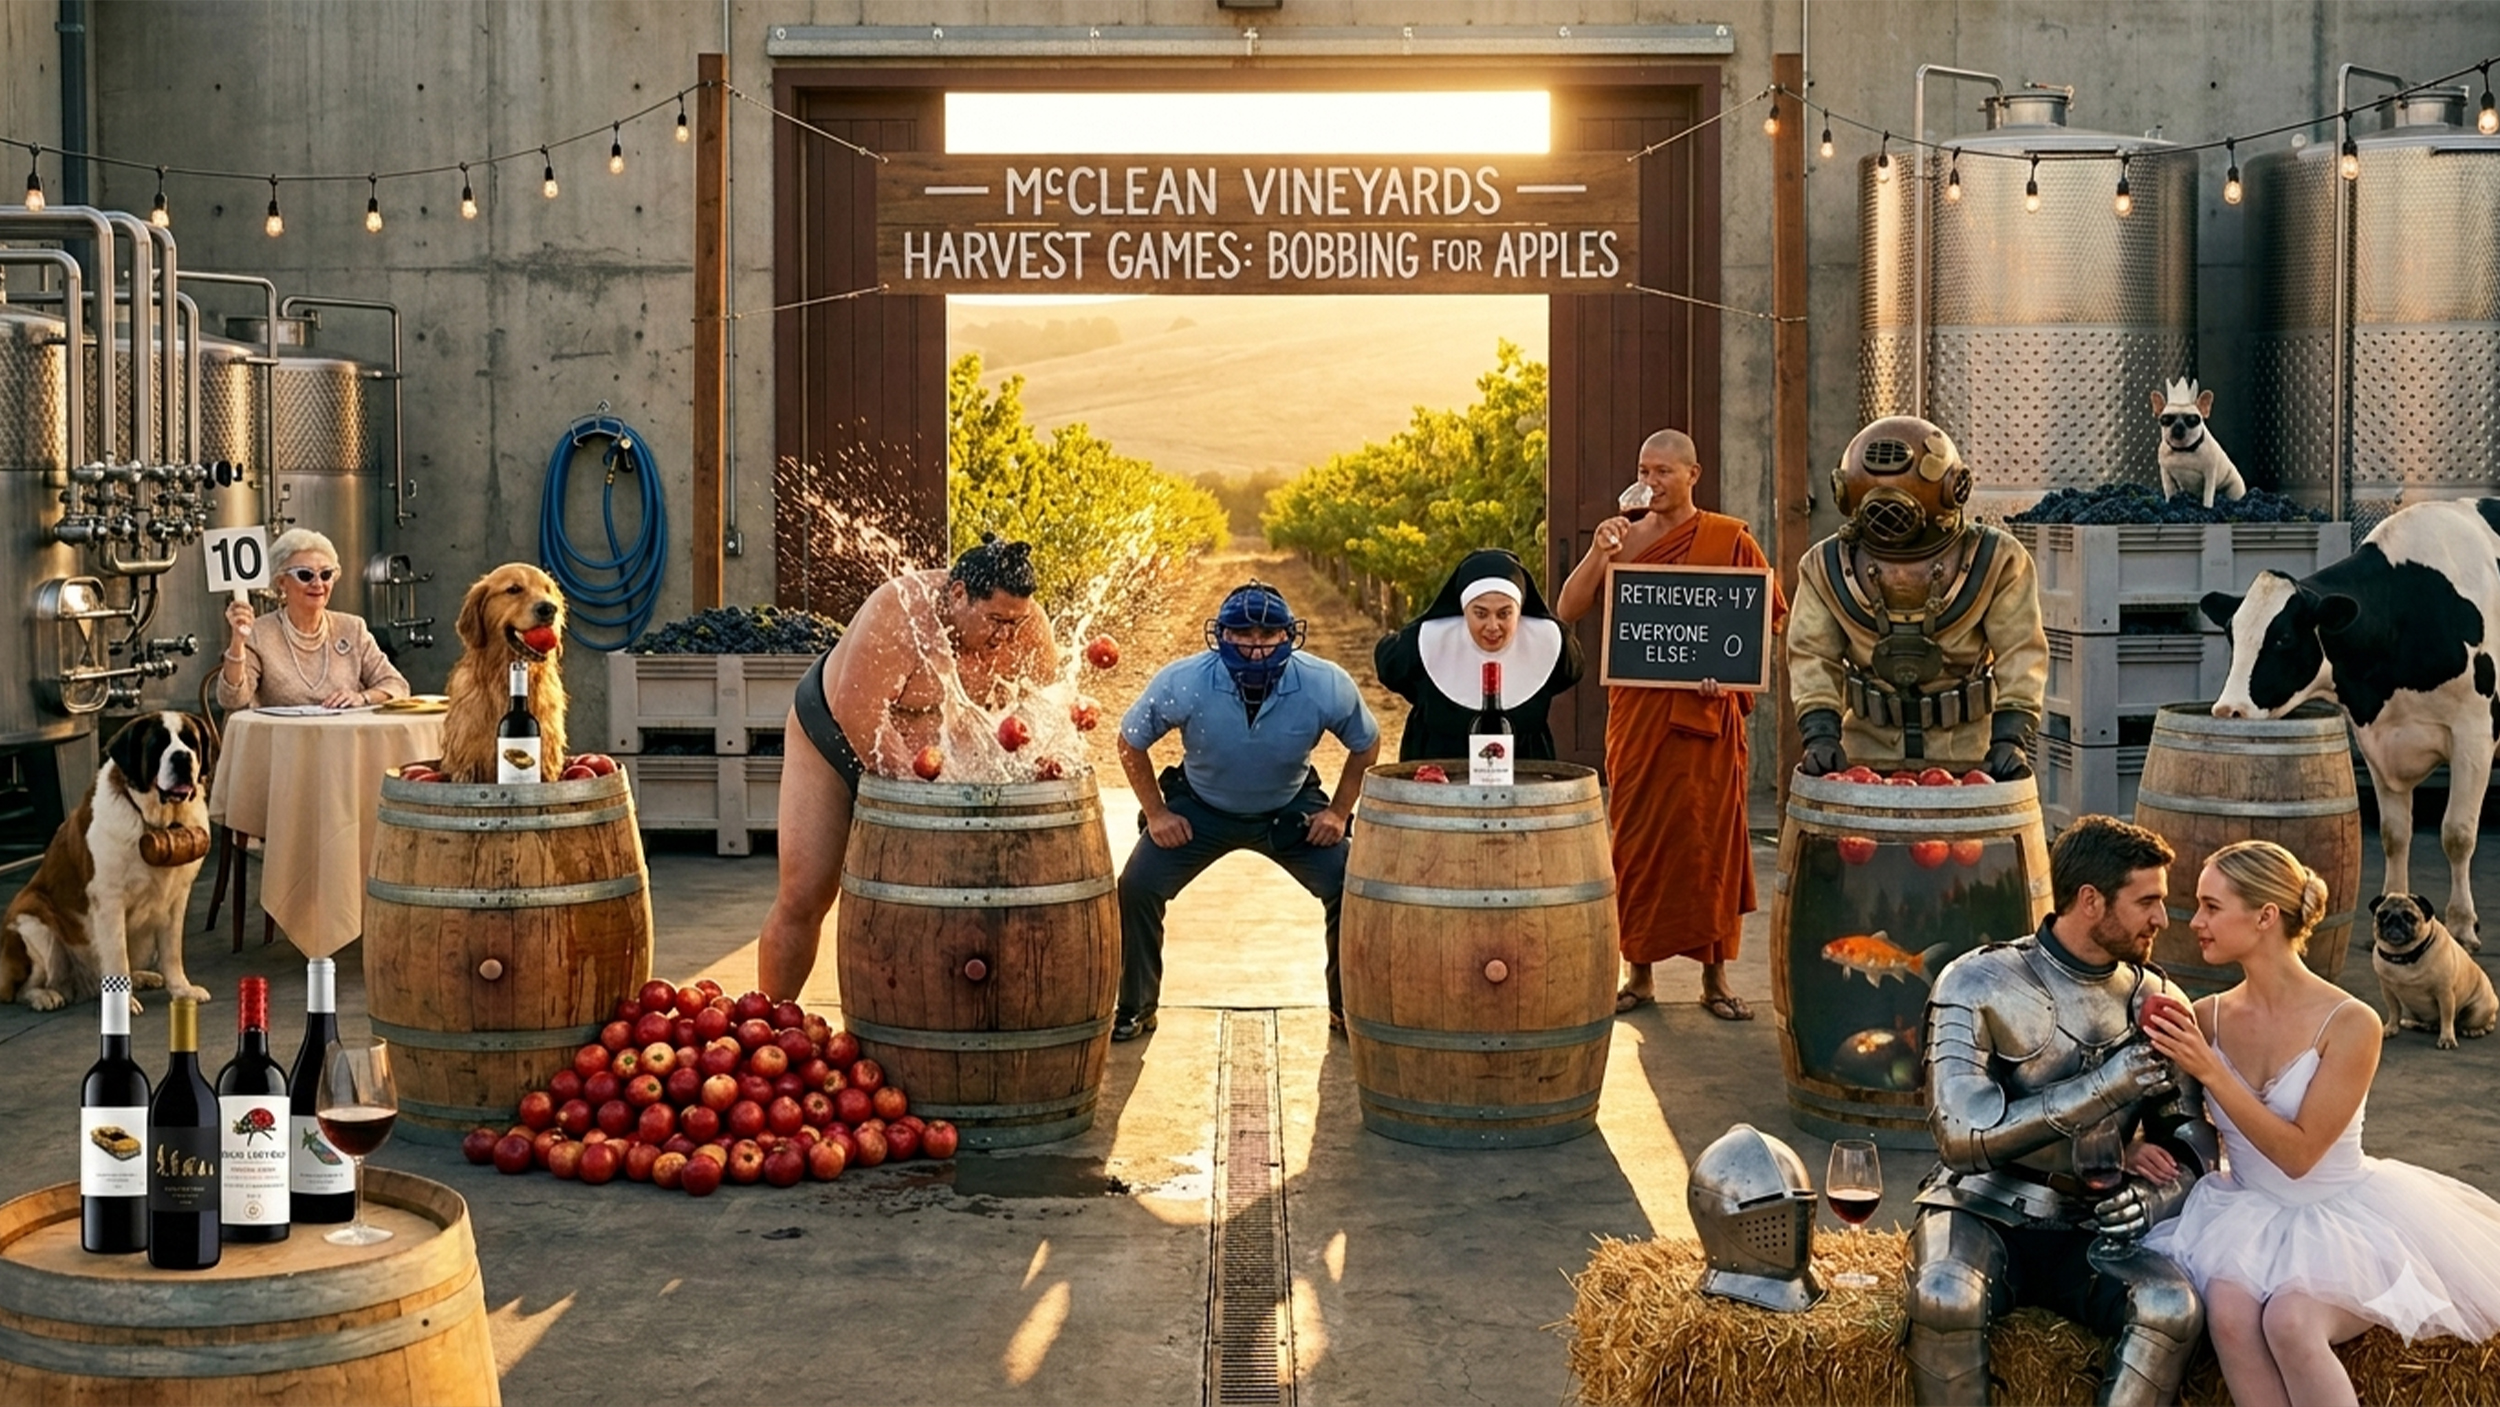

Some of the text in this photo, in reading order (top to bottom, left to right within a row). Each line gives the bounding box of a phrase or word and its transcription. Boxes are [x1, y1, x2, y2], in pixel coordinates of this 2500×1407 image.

[1243, 166, 1501, 216] VINEYARDS
[904, 231, 1619, 280] HARVEST GAMES: BOBBING FOR APPLES
[211, 536, 262, 582] 10
[1619, 622, 1709, 642] EVERYONE
[1646, 645, 1697, 663] ELSE:
